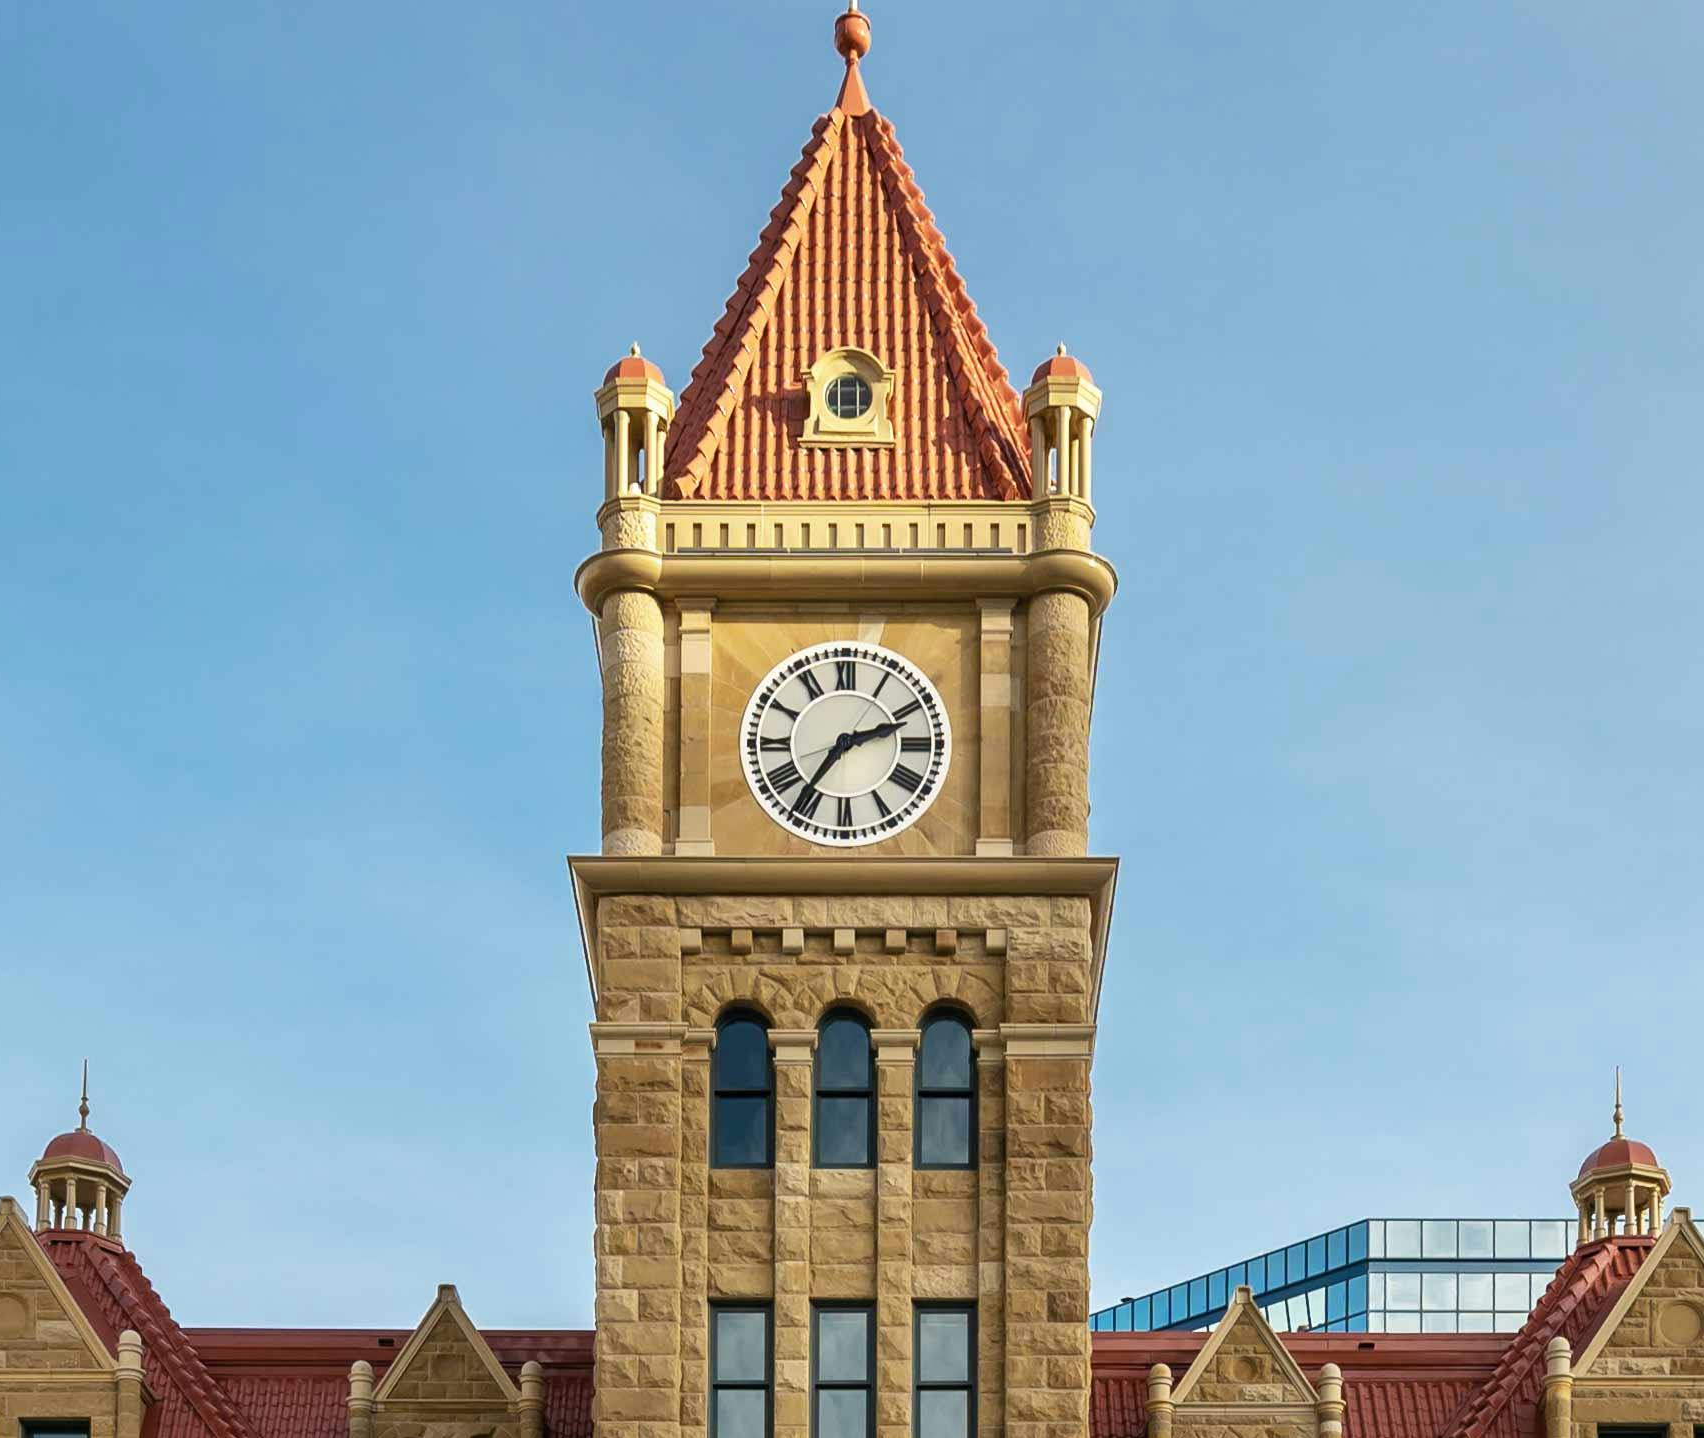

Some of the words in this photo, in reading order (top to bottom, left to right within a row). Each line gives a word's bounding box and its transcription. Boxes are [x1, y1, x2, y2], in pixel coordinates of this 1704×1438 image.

[797, 668, 824, 700] XI
[834, 660, 856, 691] XII
[872, 672, 890, 698] I
[771, 698, 800, 722] X
[892, 699, 922, 721] II
[759, 736, 791, 752] IX
[901, 737, 932, 753] III
[766, 760, 802, 795] VIII
[837, 797, 852, 827] VI
[872, 790, 892, 816] V
